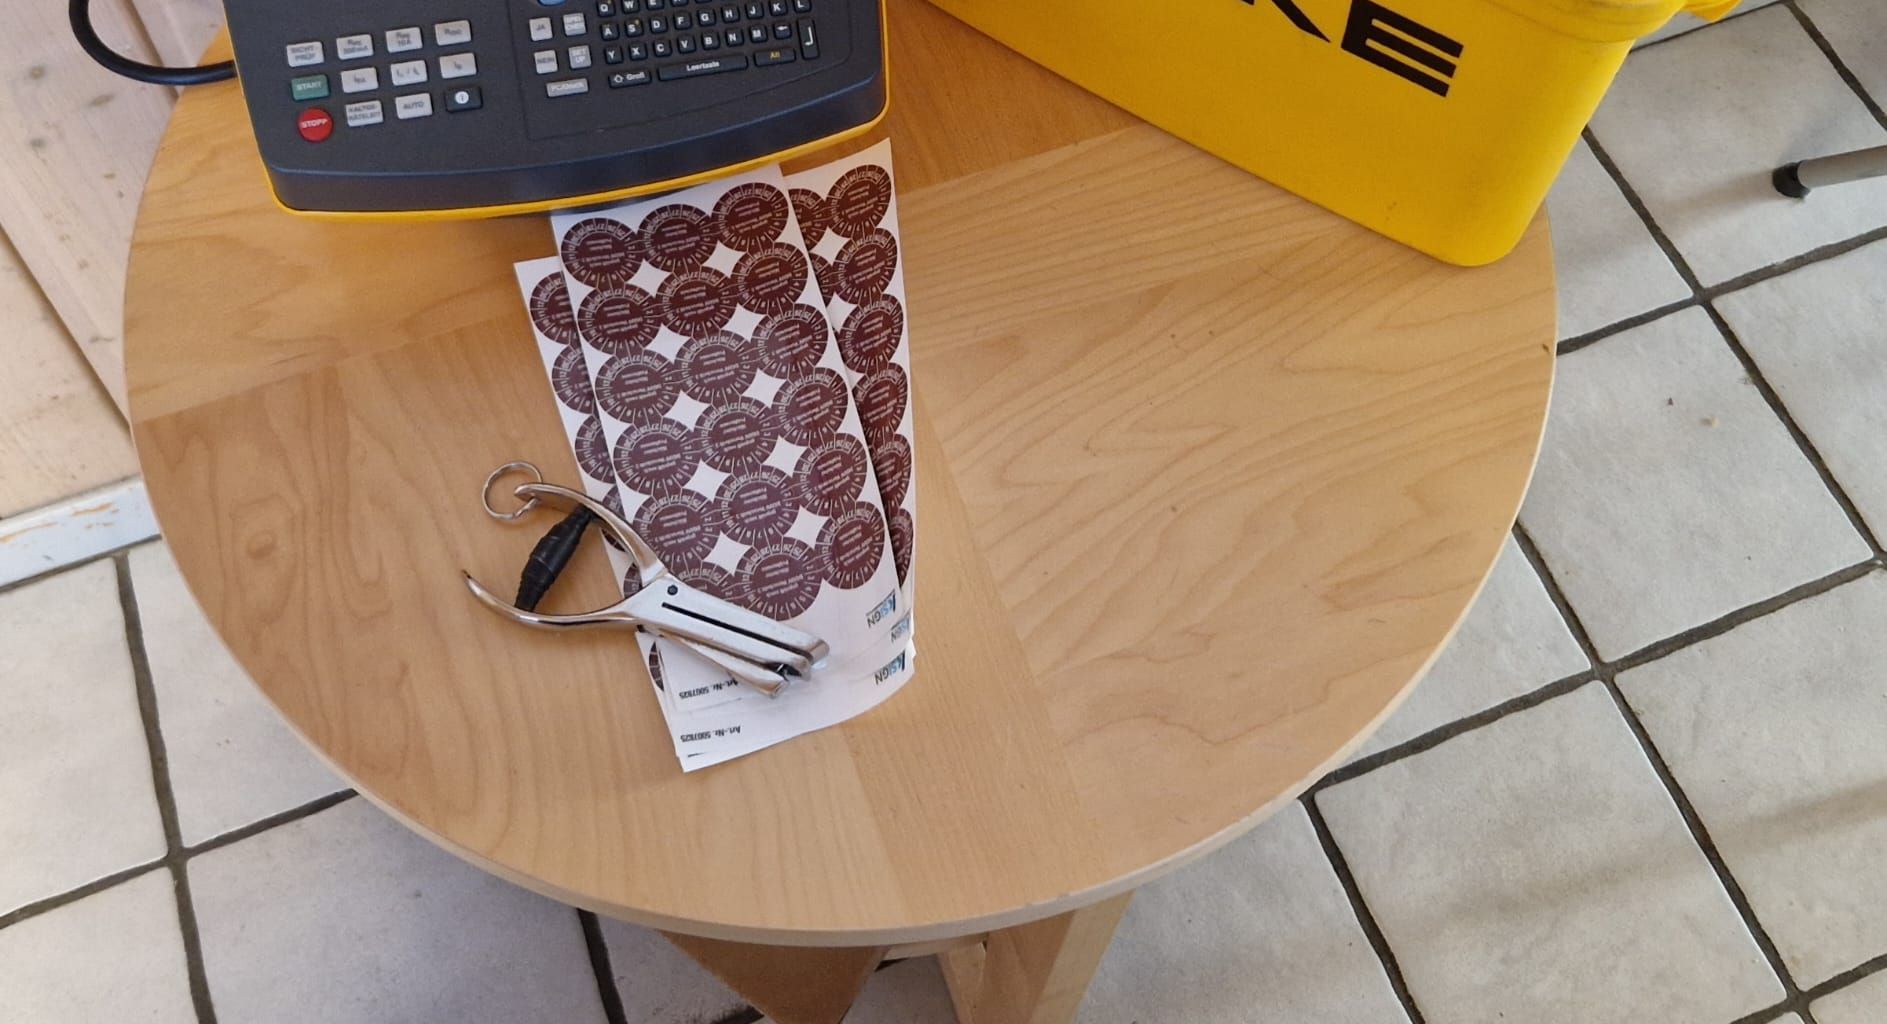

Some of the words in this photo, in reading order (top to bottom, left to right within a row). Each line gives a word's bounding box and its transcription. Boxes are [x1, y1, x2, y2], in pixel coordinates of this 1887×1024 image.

[600, 4, 608, 12] Q
[624, 0, 634, 9] W
[628, 24, 636, 32] S
[652, 20, 660, 29] D
[677, 16, 684, 25] F
[700, 13, 709, 22] G
[725, 10, 732, 18] H
[750, 6, 756, 14] J
[772, 3, 782, 12] K
[797, 0, 804, 8] L
[607, 50, 615, 60] Y
[632, 47, 640, 56] X
[656, 44, 664, 52] C
[680, 40, 688, 48] V
[704, 36, 713, 45] B
[728, 32, 736, 42] N
[752, 29, 762, 38] M
[686, 61, 720, 72] Leertaste
[296, 82, 322, 91] START
[403, 100, 424, 110] AUTO
[300, 118, 328, 128] STOPP
[712, 725, 741, 736] Art.-Nr.
